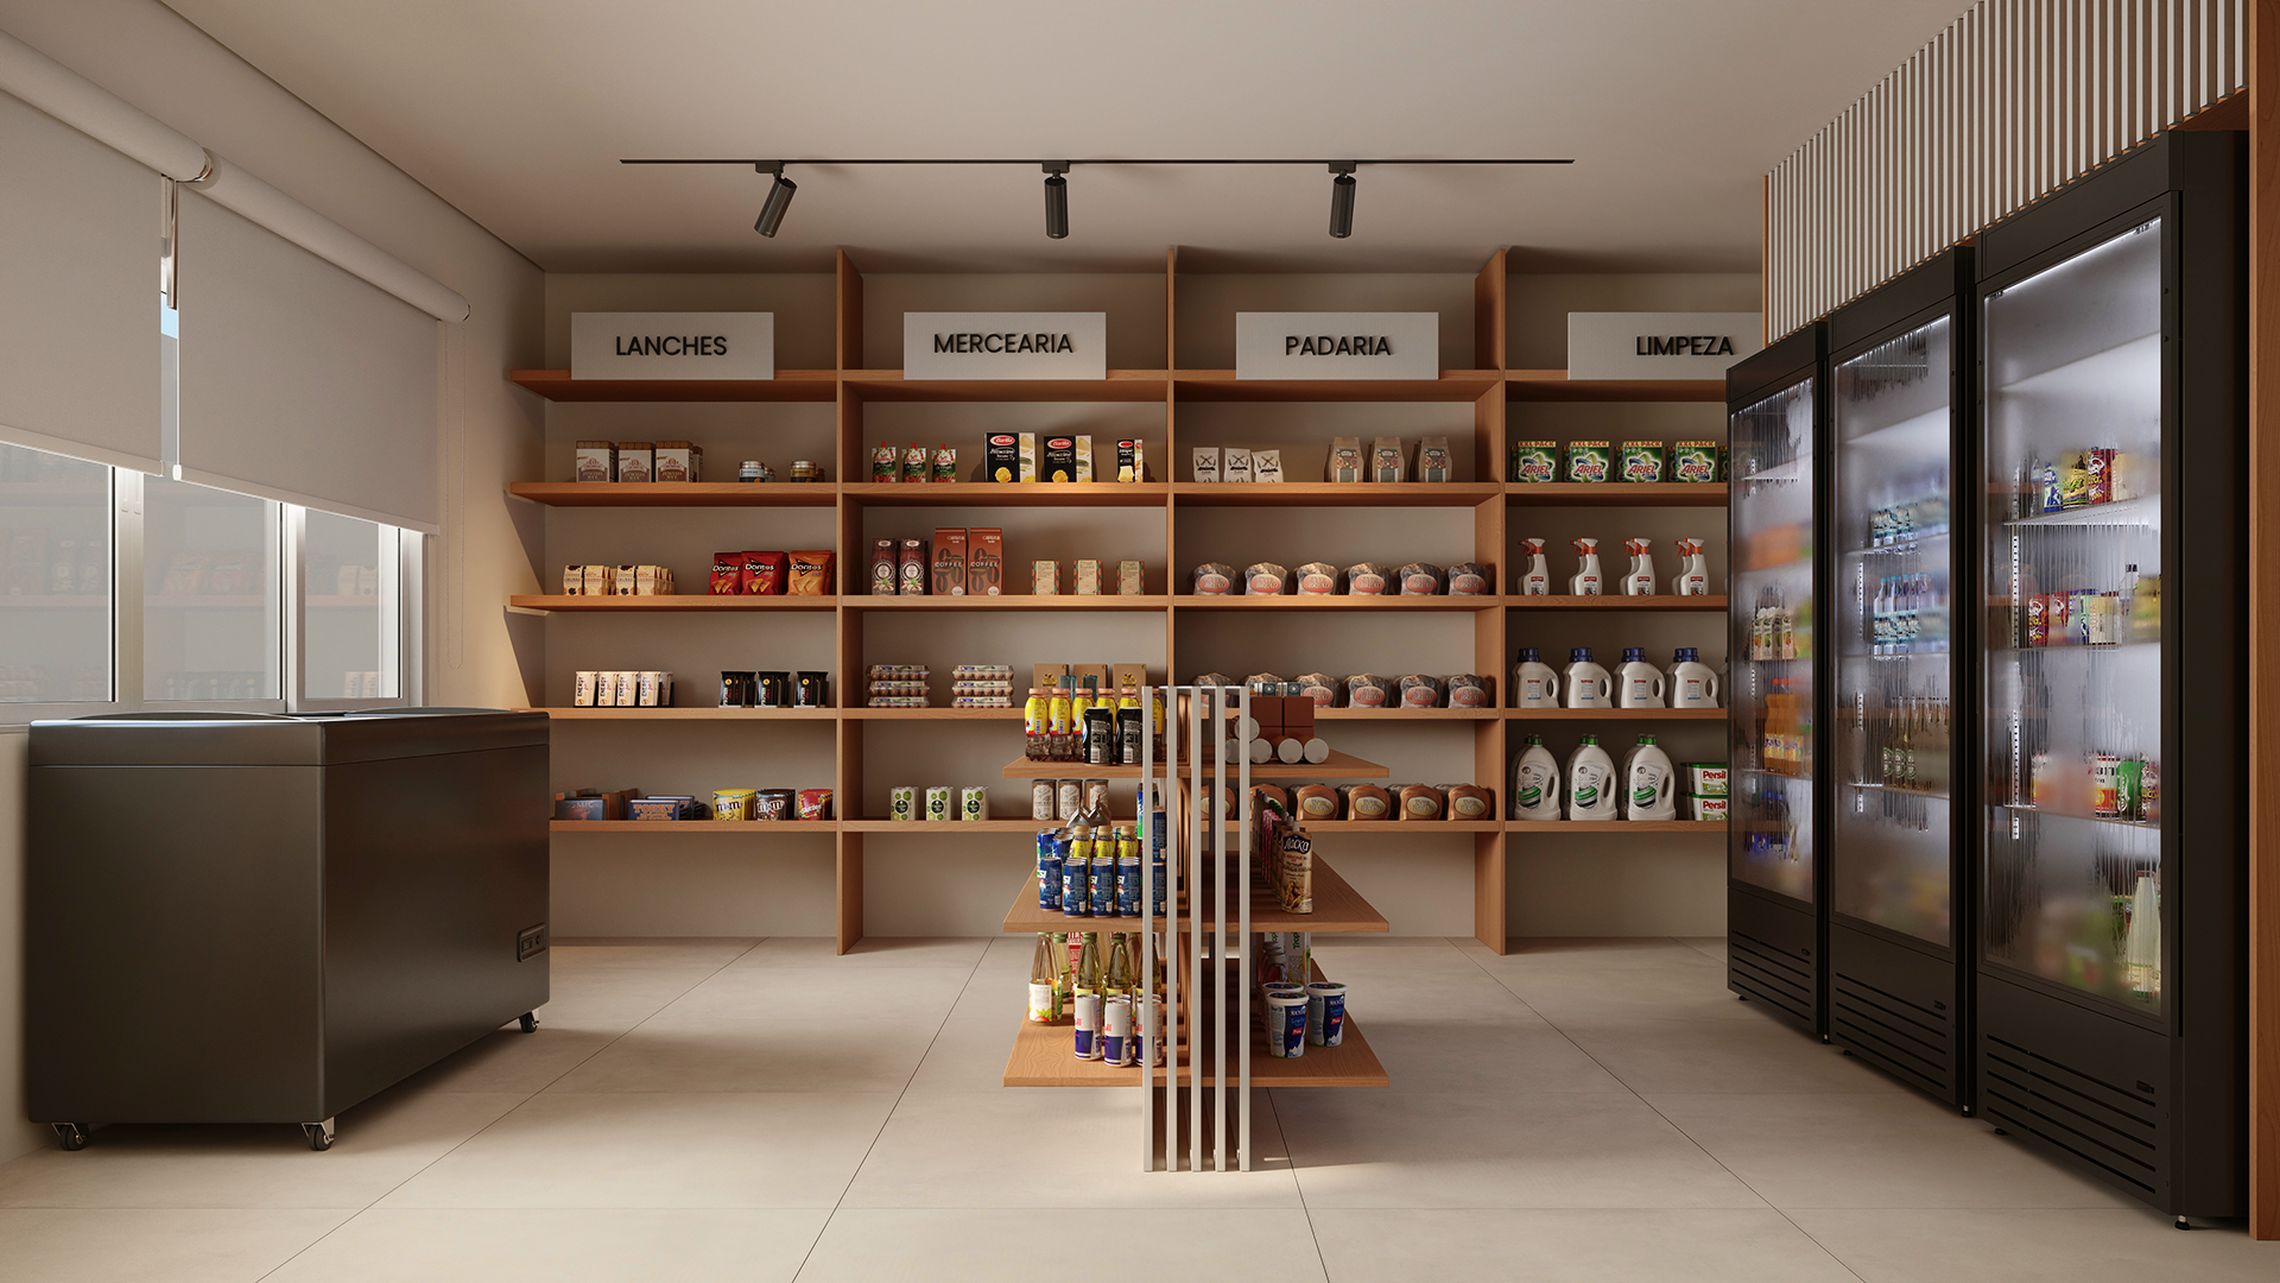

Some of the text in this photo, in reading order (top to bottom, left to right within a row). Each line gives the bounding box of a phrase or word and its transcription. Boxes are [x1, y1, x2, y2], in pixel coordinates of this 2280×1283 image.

[616, 336, 728, 356] LANCHES
[934, 333, 1074, 354] MERCEARIA
[1285, 336, 1392, 356] PADARIA
[1636, 336, 1734, 356] LIMPEZA
[1521, 465, 1550, 475] ARIEL
[1573, 465, 1603, 475] ARIEL
[1628, 465, 1656, 475] ARIEL
[1681, 465, 1710, 475] ARIEL
[712, 564, 740, 572] Doritos
[745, 563, 775, 571] Doritos
[791, 563, 823, 571] Doritos
[1703, 770, 1726, 779] Persil
[1703, 800, 1726, 809] Persil
